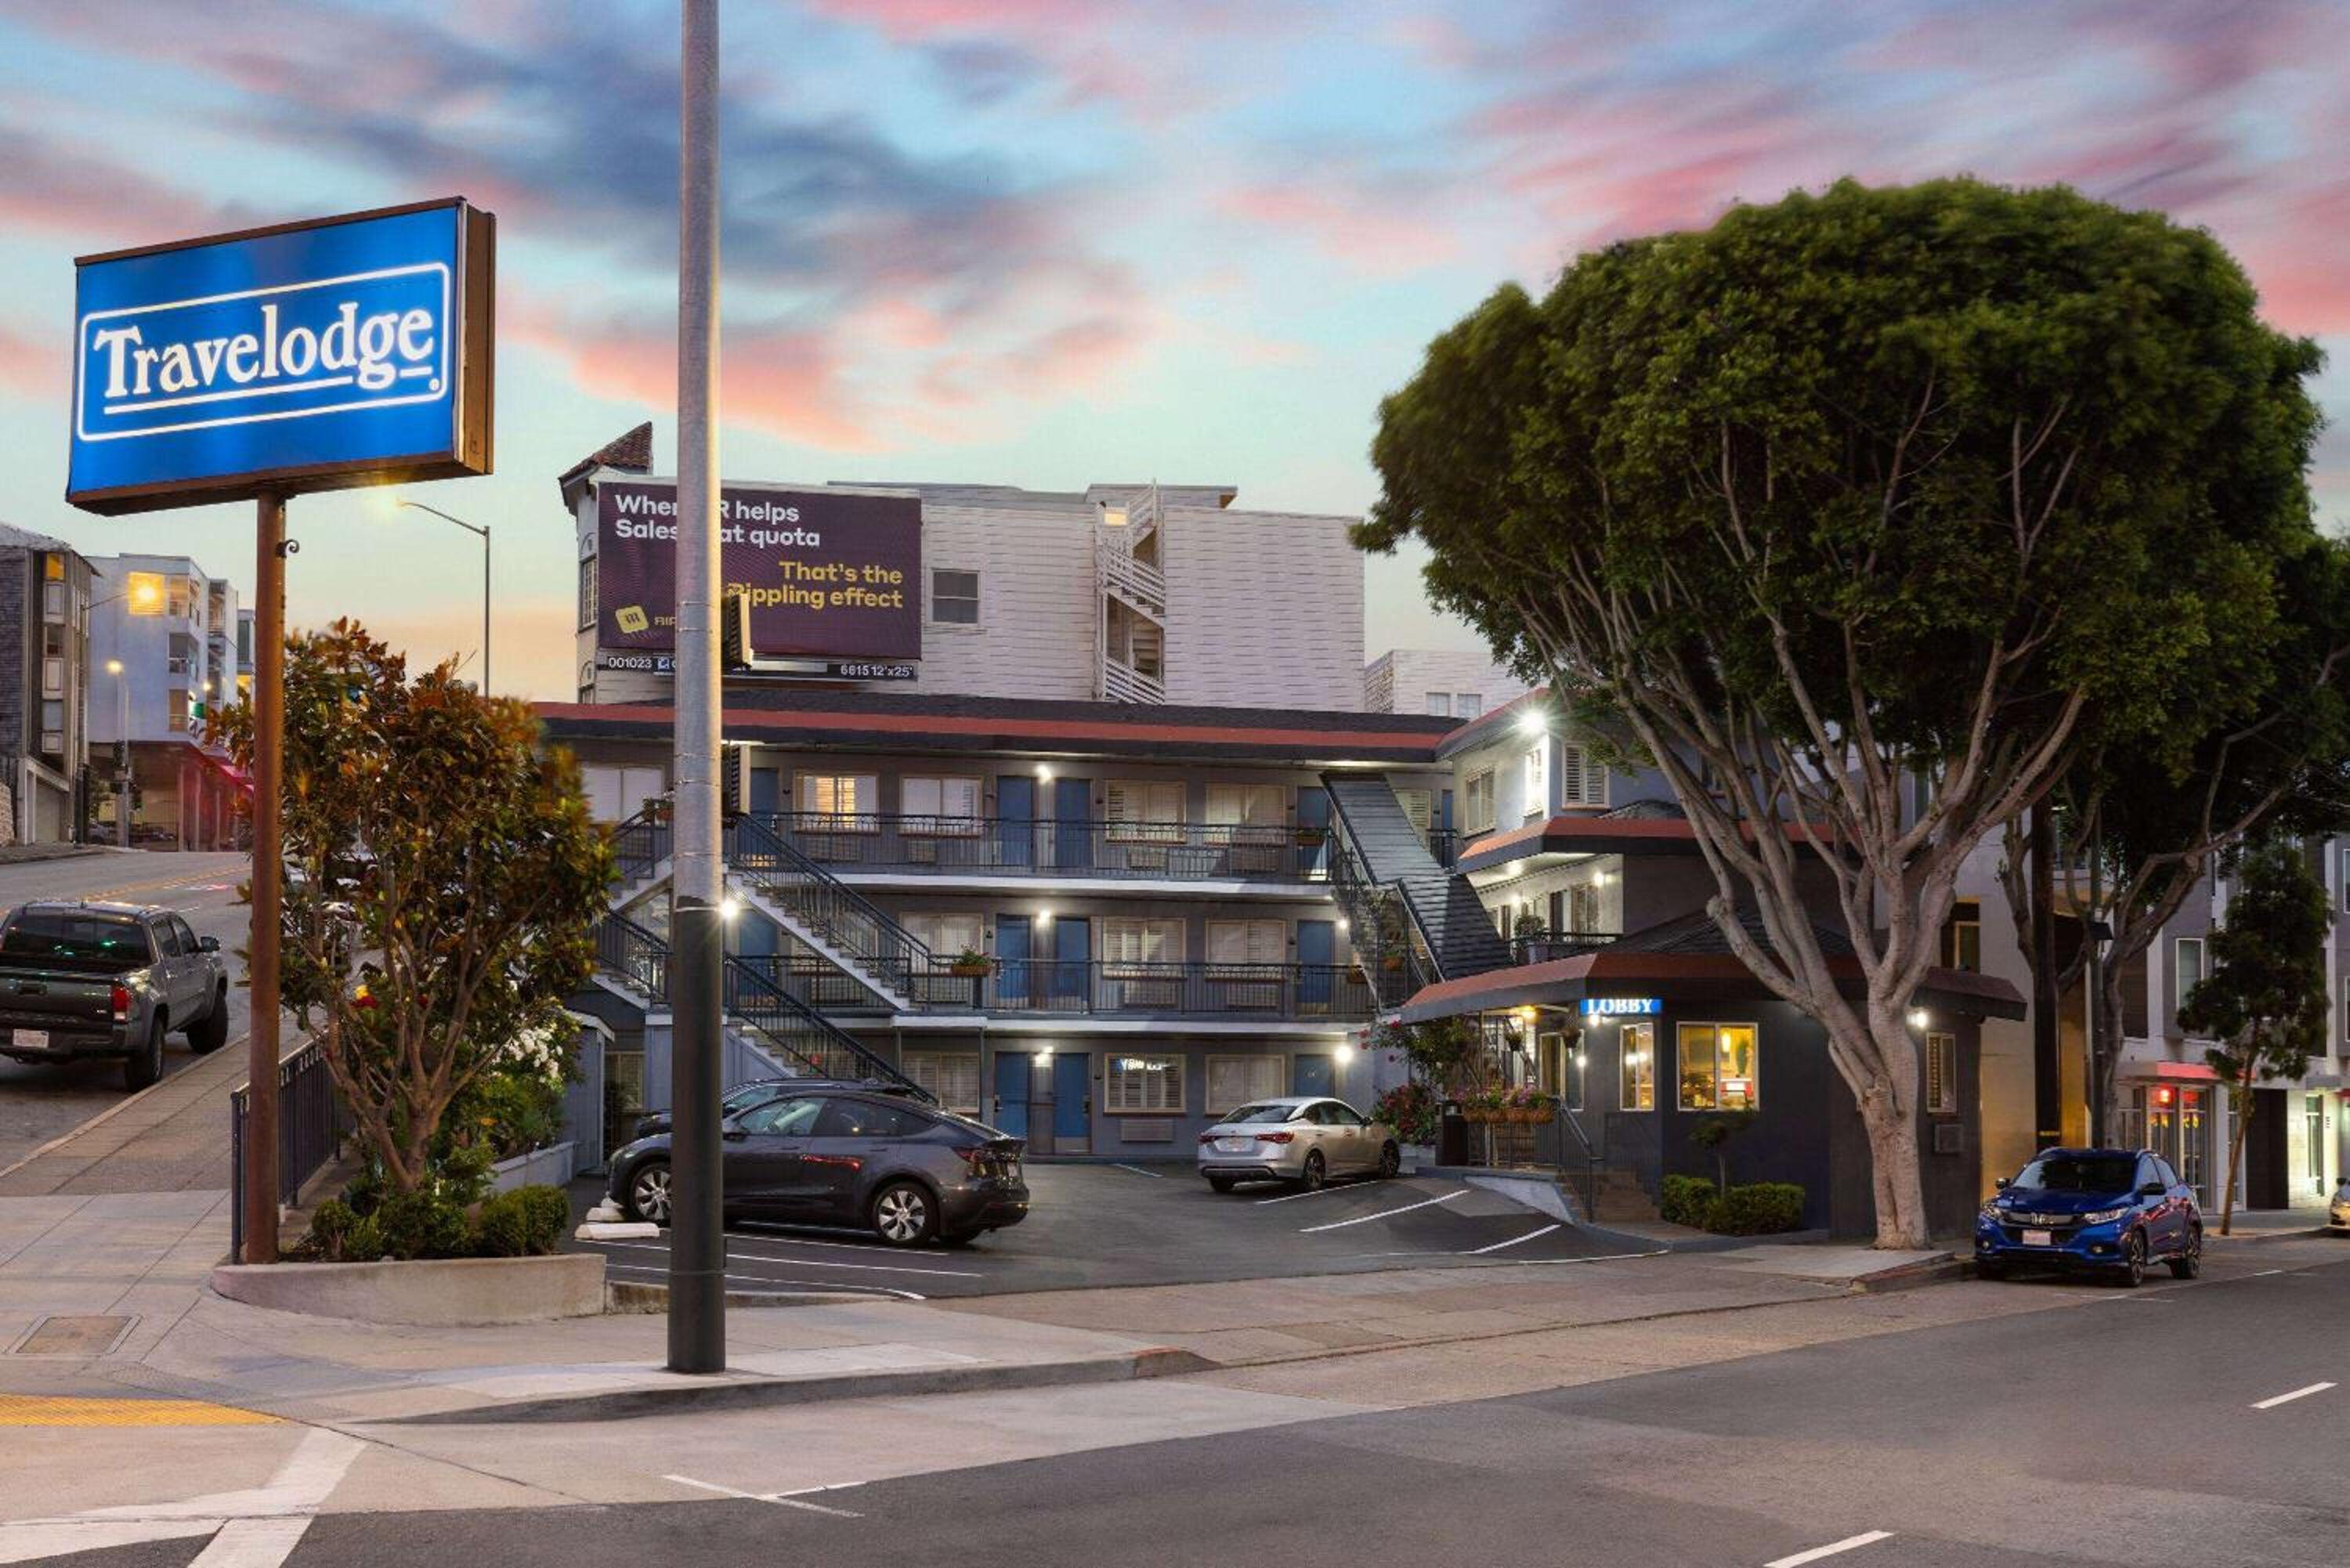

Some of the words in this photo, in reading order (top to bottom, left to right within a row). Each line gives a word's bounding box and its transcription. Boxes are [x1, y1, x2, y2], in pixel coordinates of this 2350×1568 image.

[94, 302, 433, 398] Travelodge
[736, 500, 800, 526] helps
[750, 527, 820, 549] quota
[779, 561, 858, 582] That's
[862, 565, 903, 584] the
[830, 587, 903, 609] effect
[609, 657, 653, 669] 001023
[1587, 999, 1652, 1014] LOBBY
